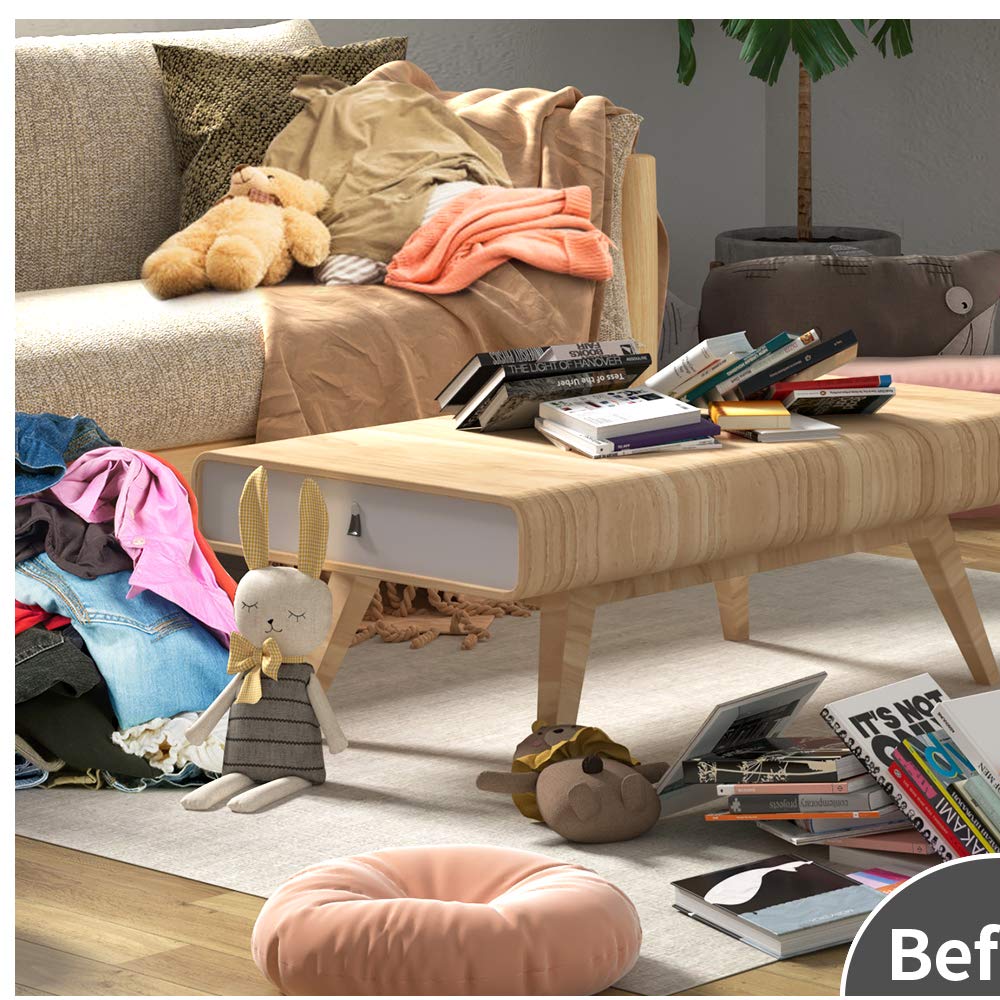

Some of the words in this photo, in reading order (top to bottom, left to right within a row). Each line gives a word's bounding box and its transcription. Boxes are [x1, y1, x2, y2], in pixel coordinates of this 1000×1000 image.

[508, 364, 530, 374] THE
[530, 361, 558, 372] LIGHT
[559, 359, 574, 370] OF
[573, 356, 623, 369] HANOVER
[557, 377, 581, 387] Urber
[581, 375, 595, 384] the
[595, 374, 606, 382] of
[606, 373, 625, 381] Tess
[848, 706, 901, 739] IT'S
[893, 689, 943, 724] NOT
[977, 761, 996, 782] MEN
[769, 798, 800, 810] projects
[799, 798, 849, 811] contemporary
[935, 796, 987, 856] AKAMI
